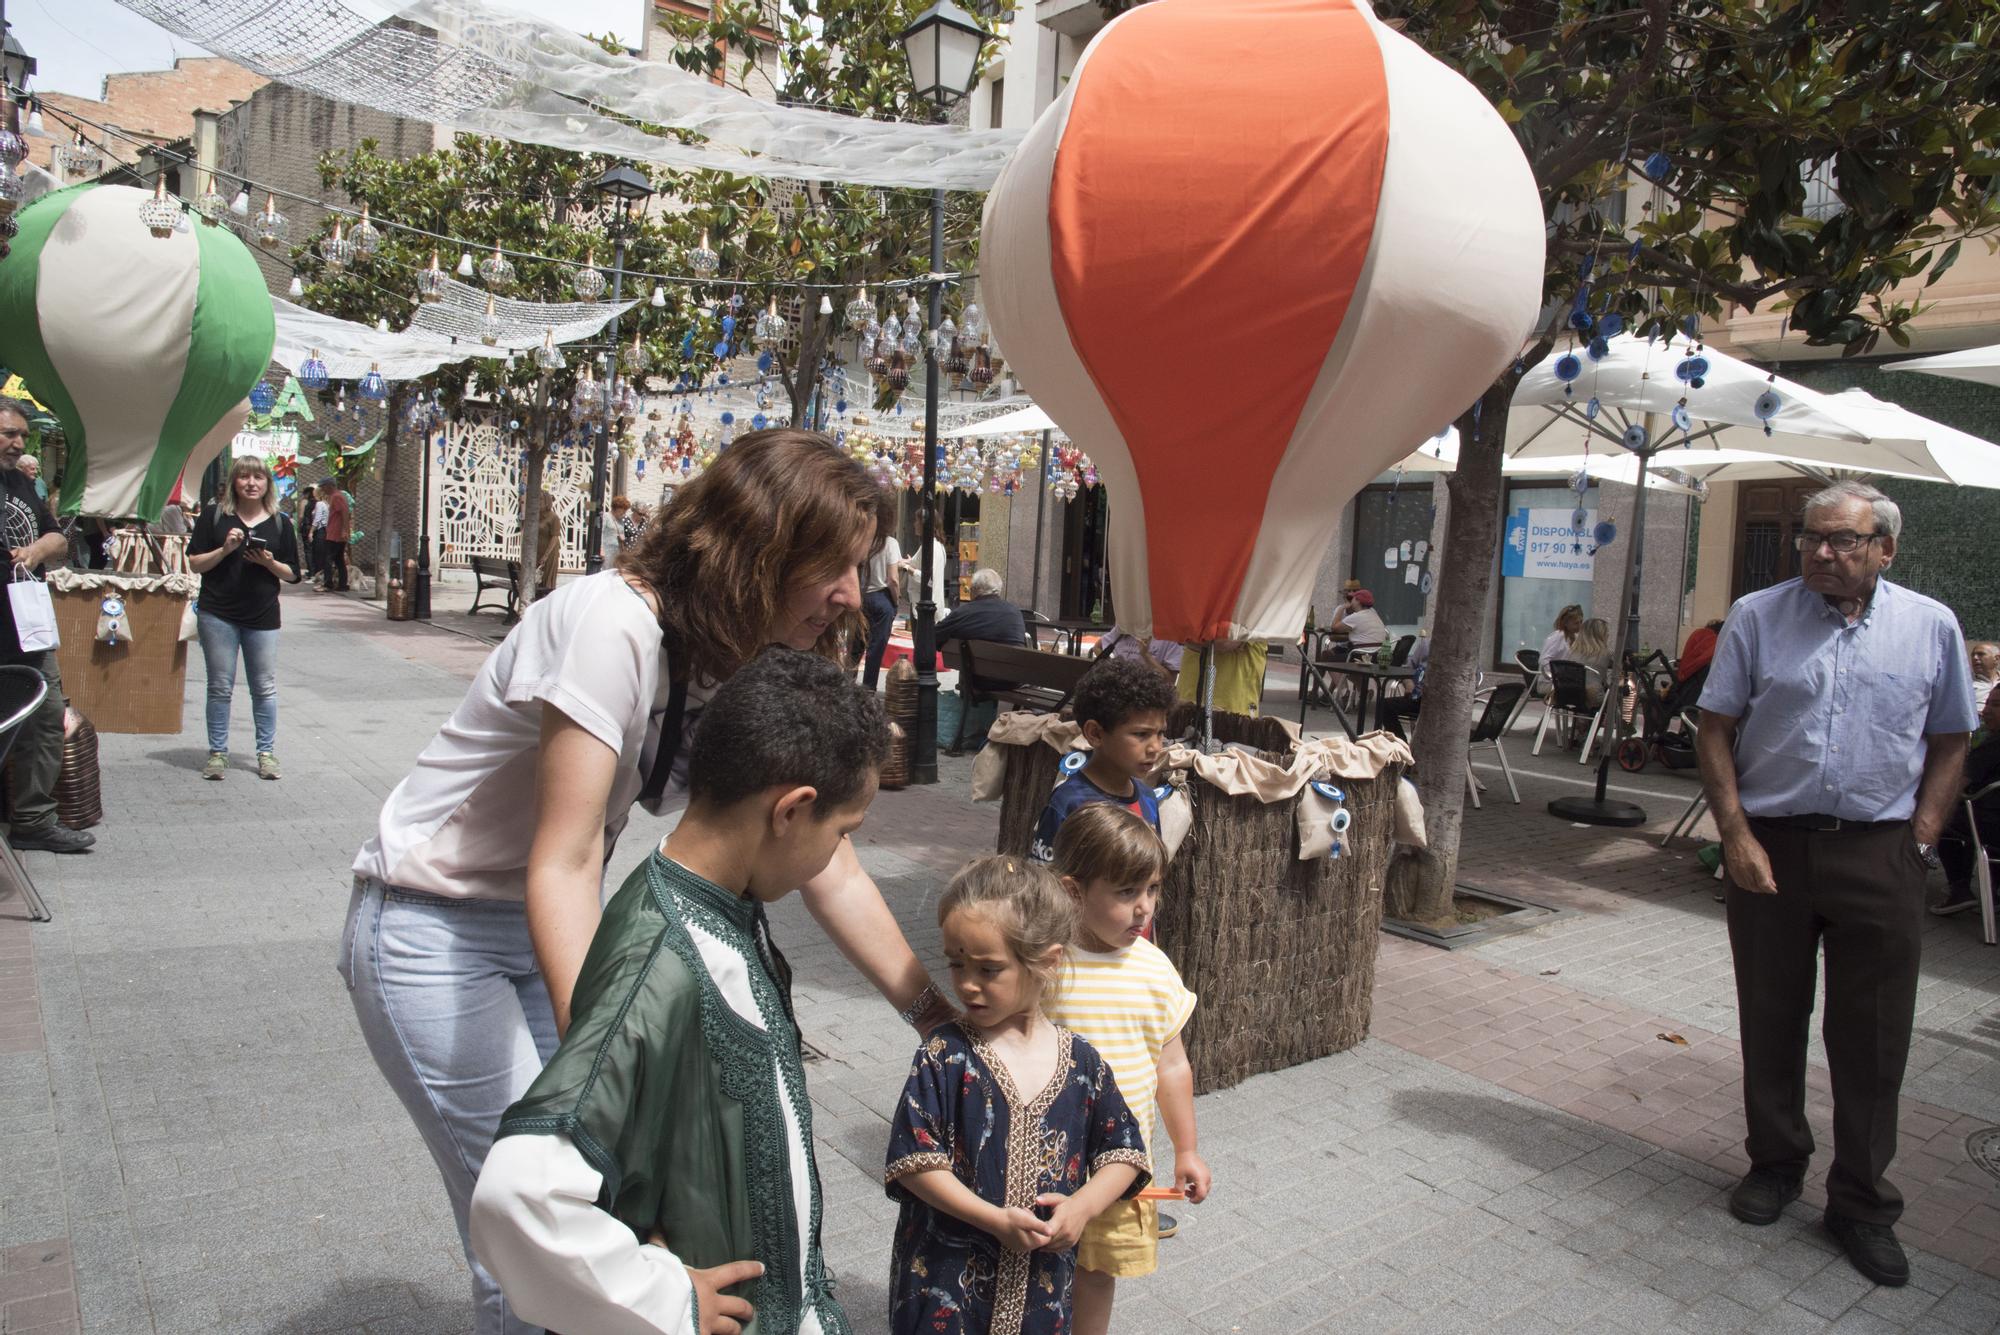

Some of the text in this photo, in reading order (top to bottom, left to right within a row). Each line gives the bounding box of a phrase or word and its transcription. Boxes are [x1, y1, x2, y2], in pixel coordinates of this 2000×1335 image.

[1532, 526, 1593, 538] DISPONBL
[1531, 542, 1550, 554] 917
[1553, 543, 1566, 554] 90
[1537, 560, 1590, 570] www.haya.es
